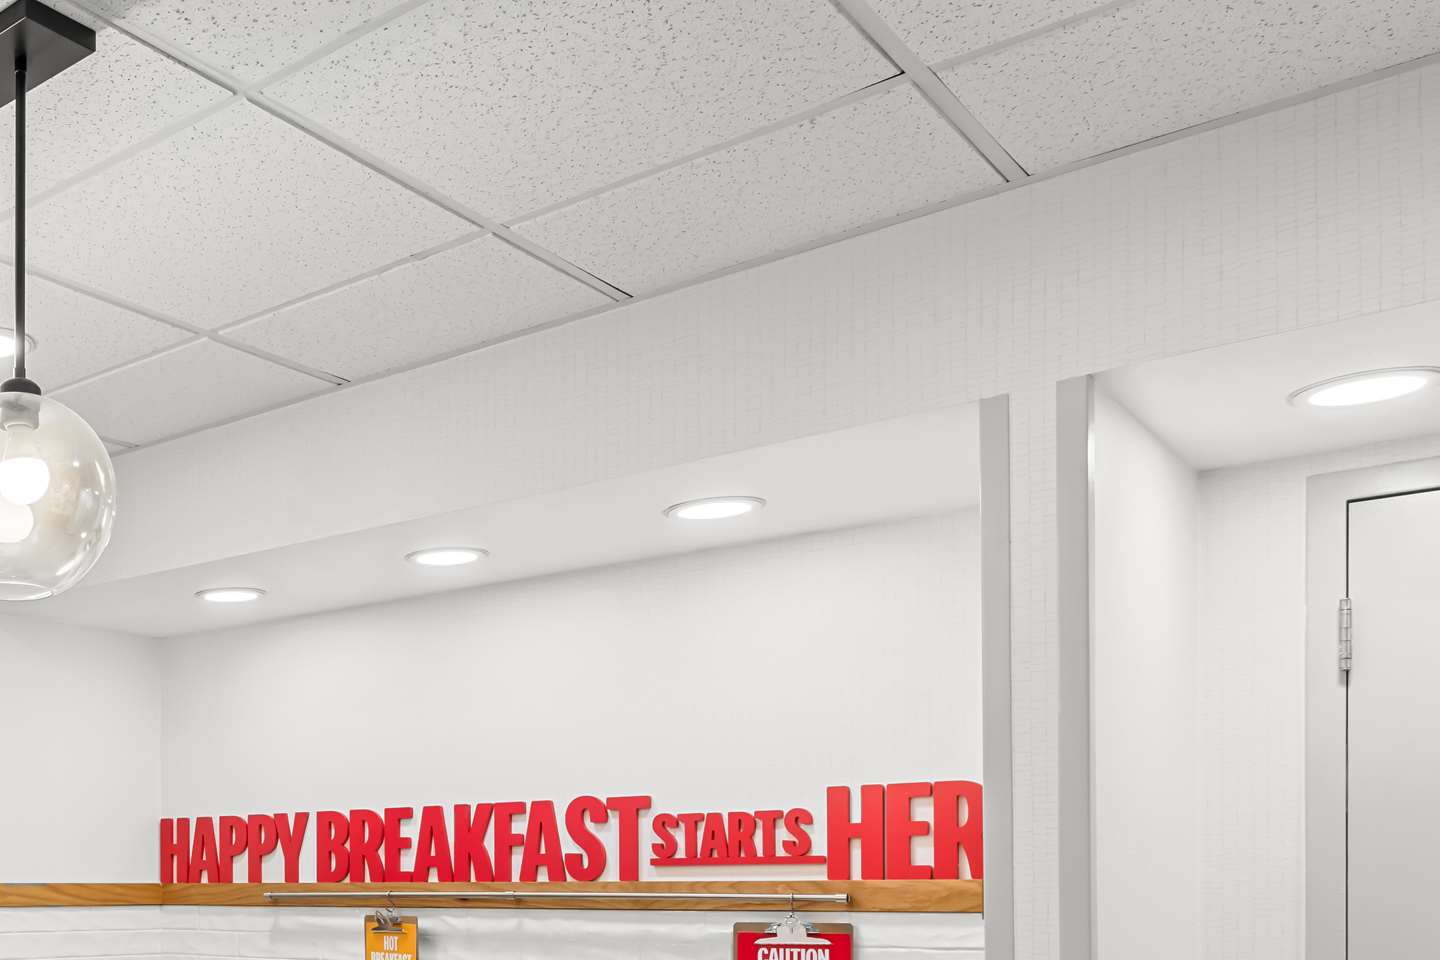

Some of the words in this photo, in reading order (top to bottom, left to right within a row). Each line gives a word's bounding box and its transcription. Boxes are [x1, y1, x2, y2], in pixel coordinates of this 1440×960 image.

[160, 811, 310, 883] HAPPY
[316, 795, 652, 883] BREAKFAST
[651, 808, 814, 858] STARTS
[826, 780, 983, 881] HER
[383, 935, 398, 951] HOT
